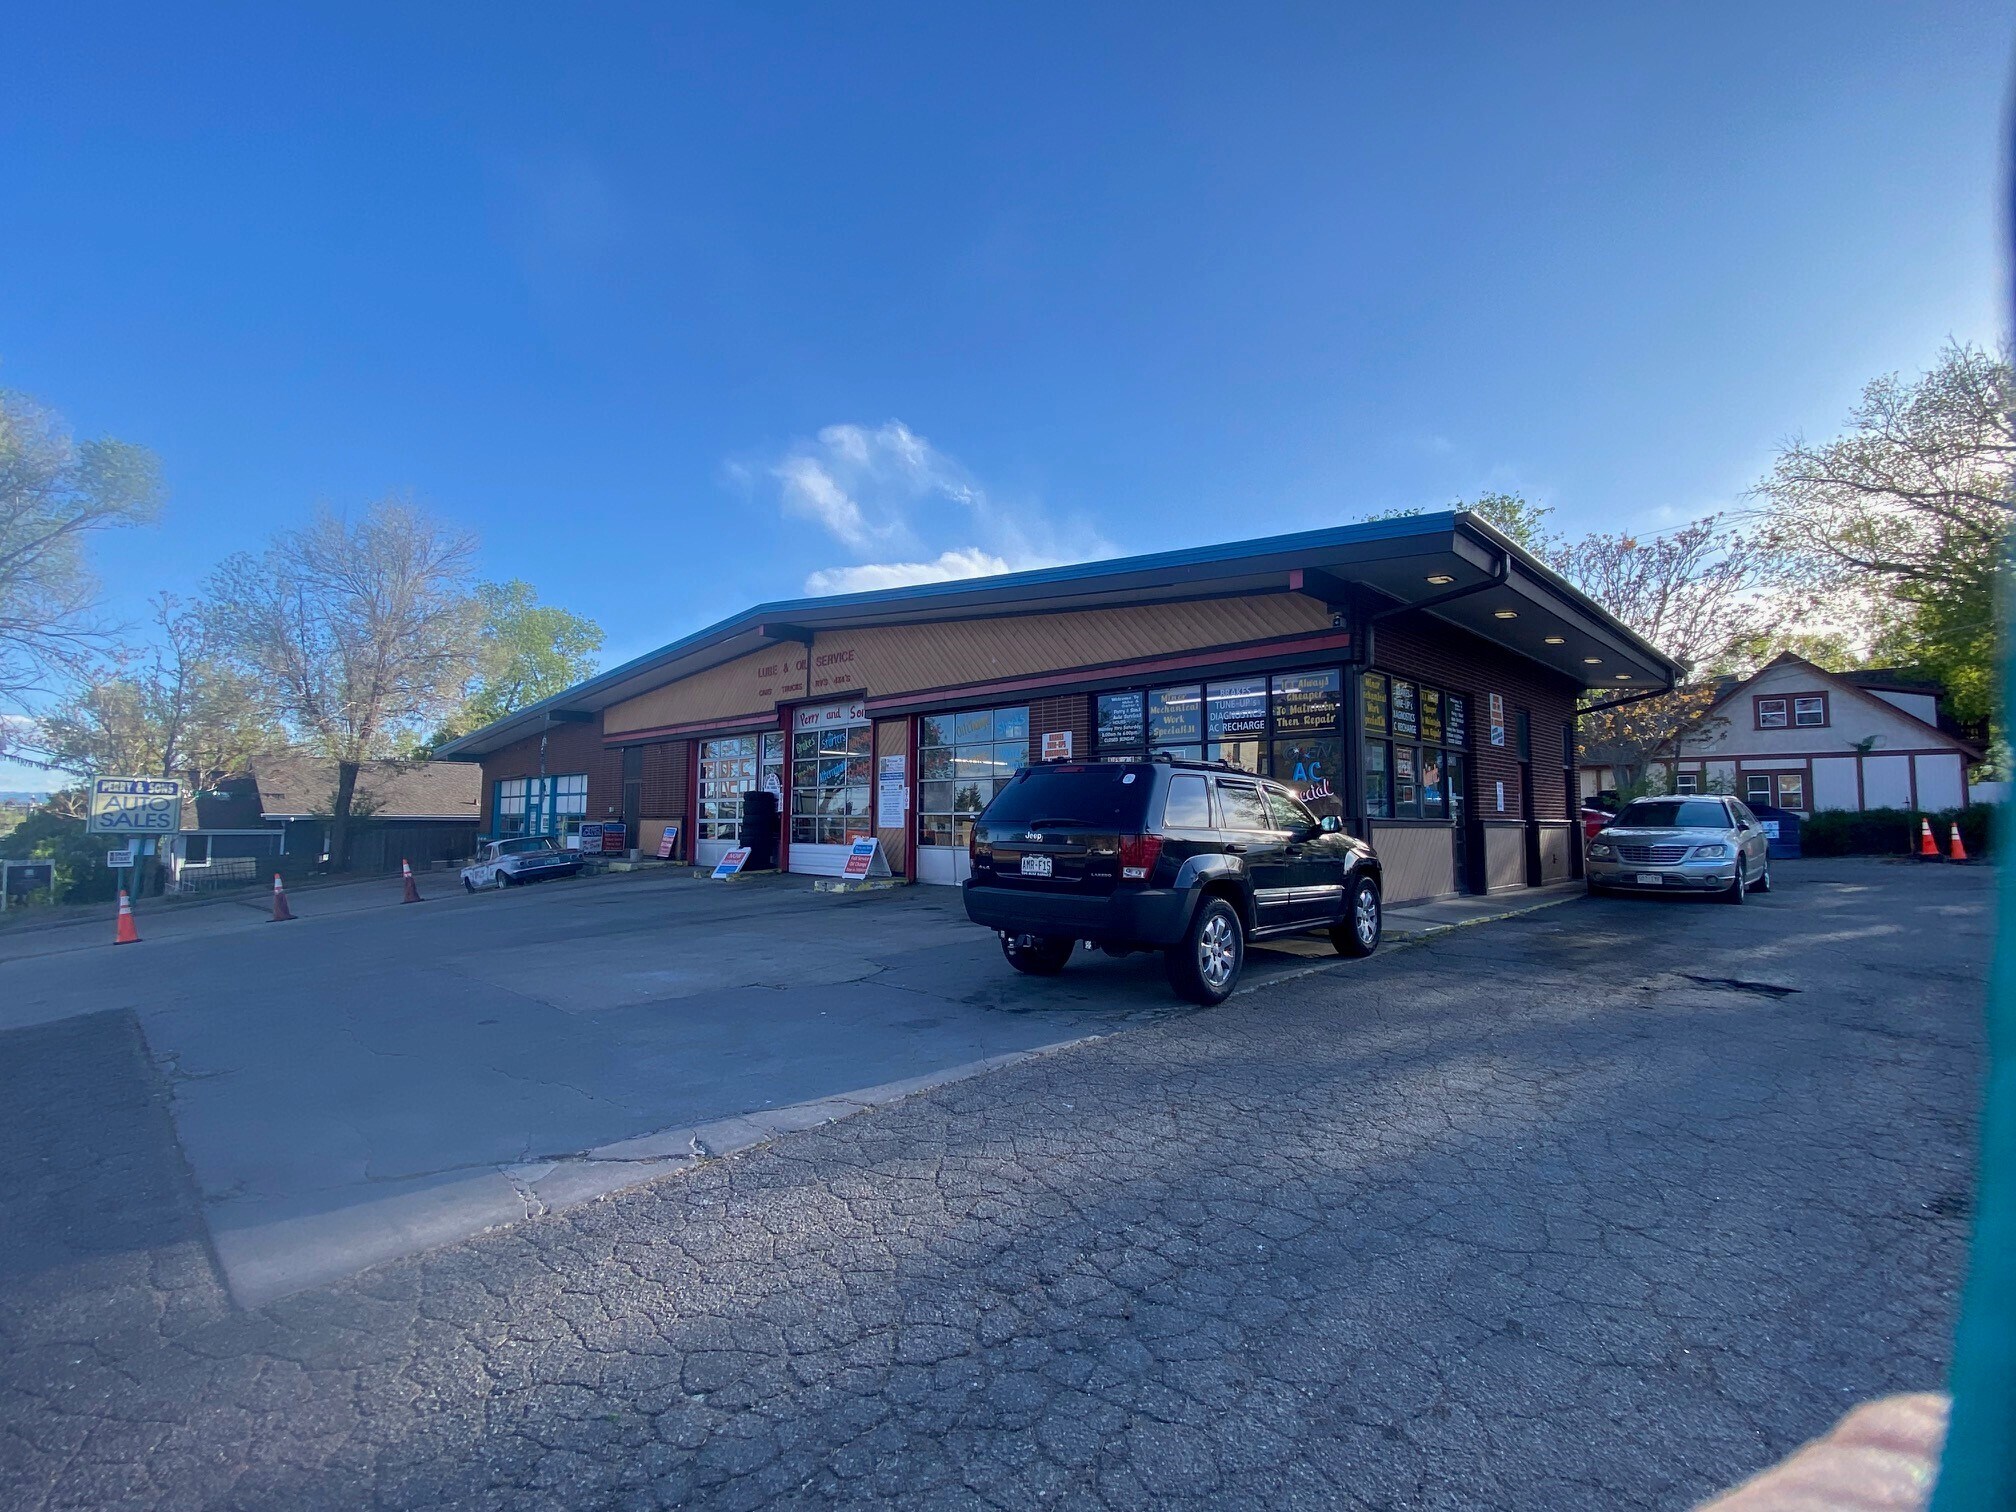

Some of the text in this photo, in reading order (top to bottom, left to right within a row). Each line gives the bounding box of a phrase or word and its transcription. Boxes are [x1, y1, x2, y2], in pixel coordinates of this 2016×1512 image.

[758, 649, 855, 678] LUBE & OIL SERVICE
[1298, 676, 1329, 689] Always
[1161, 693, 1186, 702] Minor
[1220, 687, 1251, 697] BRAKES
[1286, 691, 1323, 702] Cheaper
[1150, 703, 1199, 714] Mechanical
[1276, 706, 1286, 715] To
[800, 713, 819, 727] Perry
[826, 708, 841, 719] and
[1163, 715, 1184, 724] Work
[1276, 713, 1336, 727] Then Repair
[1209, 720, 1265, 732] AC RECHARGE
[1293, 761, 1322, 782] AC
[101, 781, 174, 794] PERRY & SONS
[1300, 779, 1334, 802] ecial
[103, 796, 171, 811] AUTO
[100, 812, 171, 828] SALES
[1025, 831, 1042, 841] Jeep
